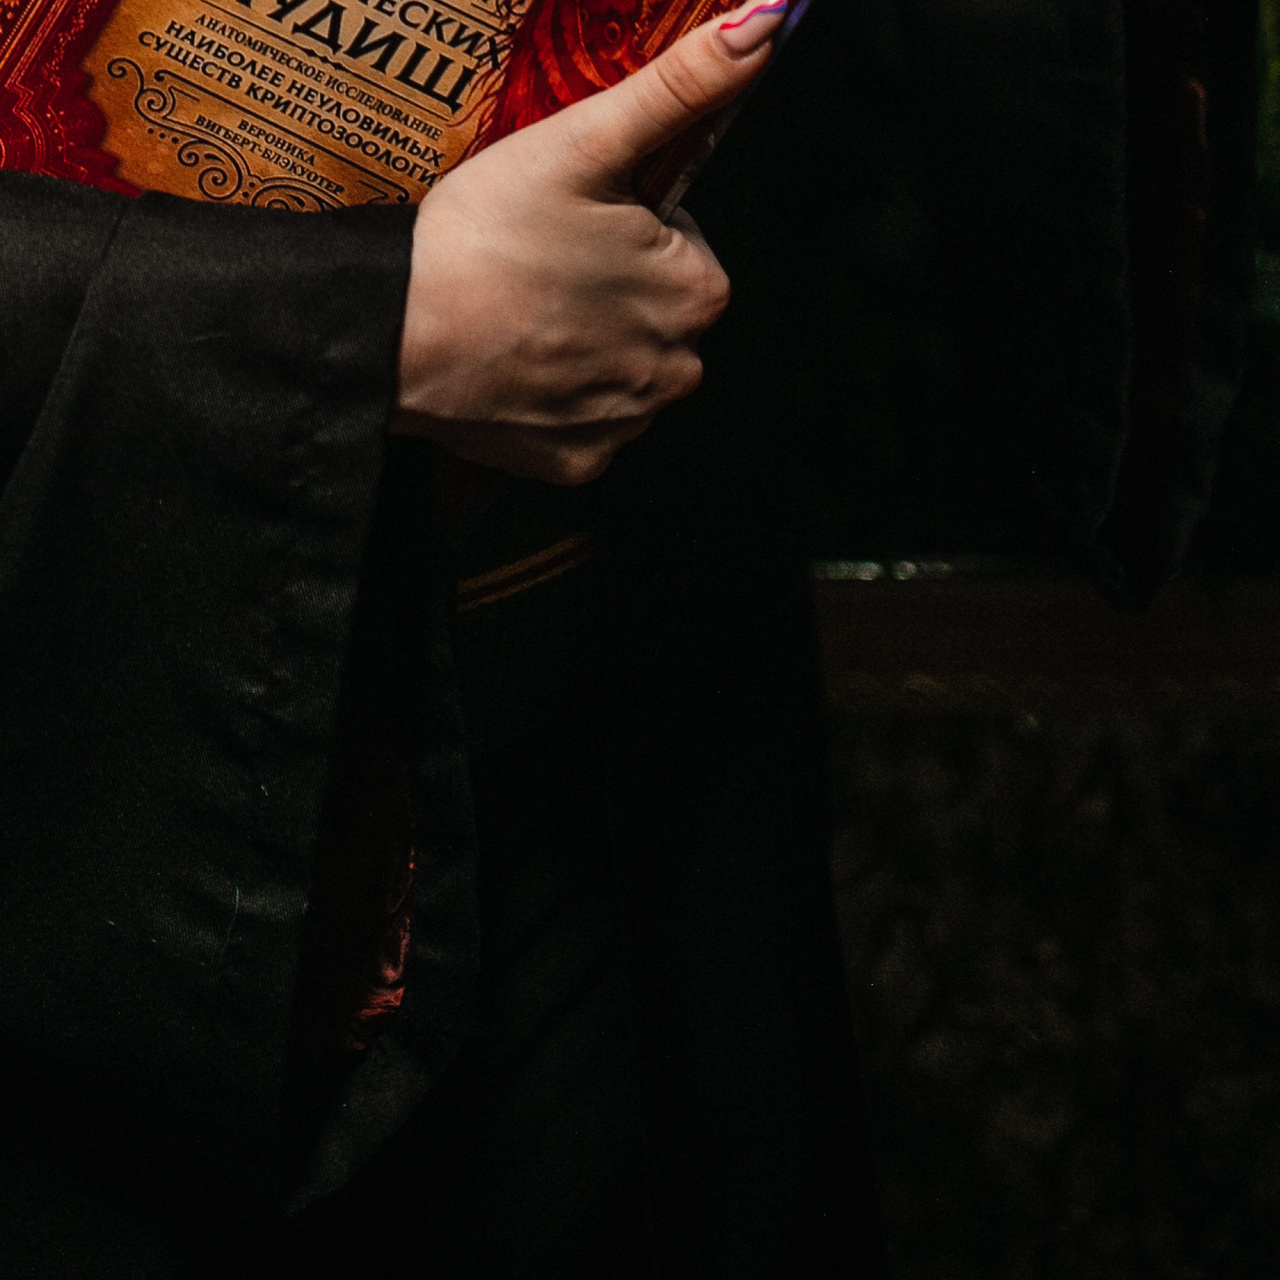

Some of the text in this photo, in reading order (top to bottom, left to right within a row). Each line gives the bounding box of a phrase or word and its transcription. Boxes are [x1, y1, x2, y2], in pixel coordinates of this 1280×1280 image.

[138, 30, 443, 188] СУЩЕСТВ КРИПТОЗООЛОГИ
[165, 19, 446, 168] НАИБОЛЕЕ НЕУЛОВИМЫХ
[195, 13, 444, 141] АНАТОМИЧЕСКОЕ ИССЛЕДОВАНИЕ
[195, 114, 346, 196] ВИГБЕРТ-БЛЭКУОТЕР
[238, 119, 316, 167] ВЕРОНИКА
